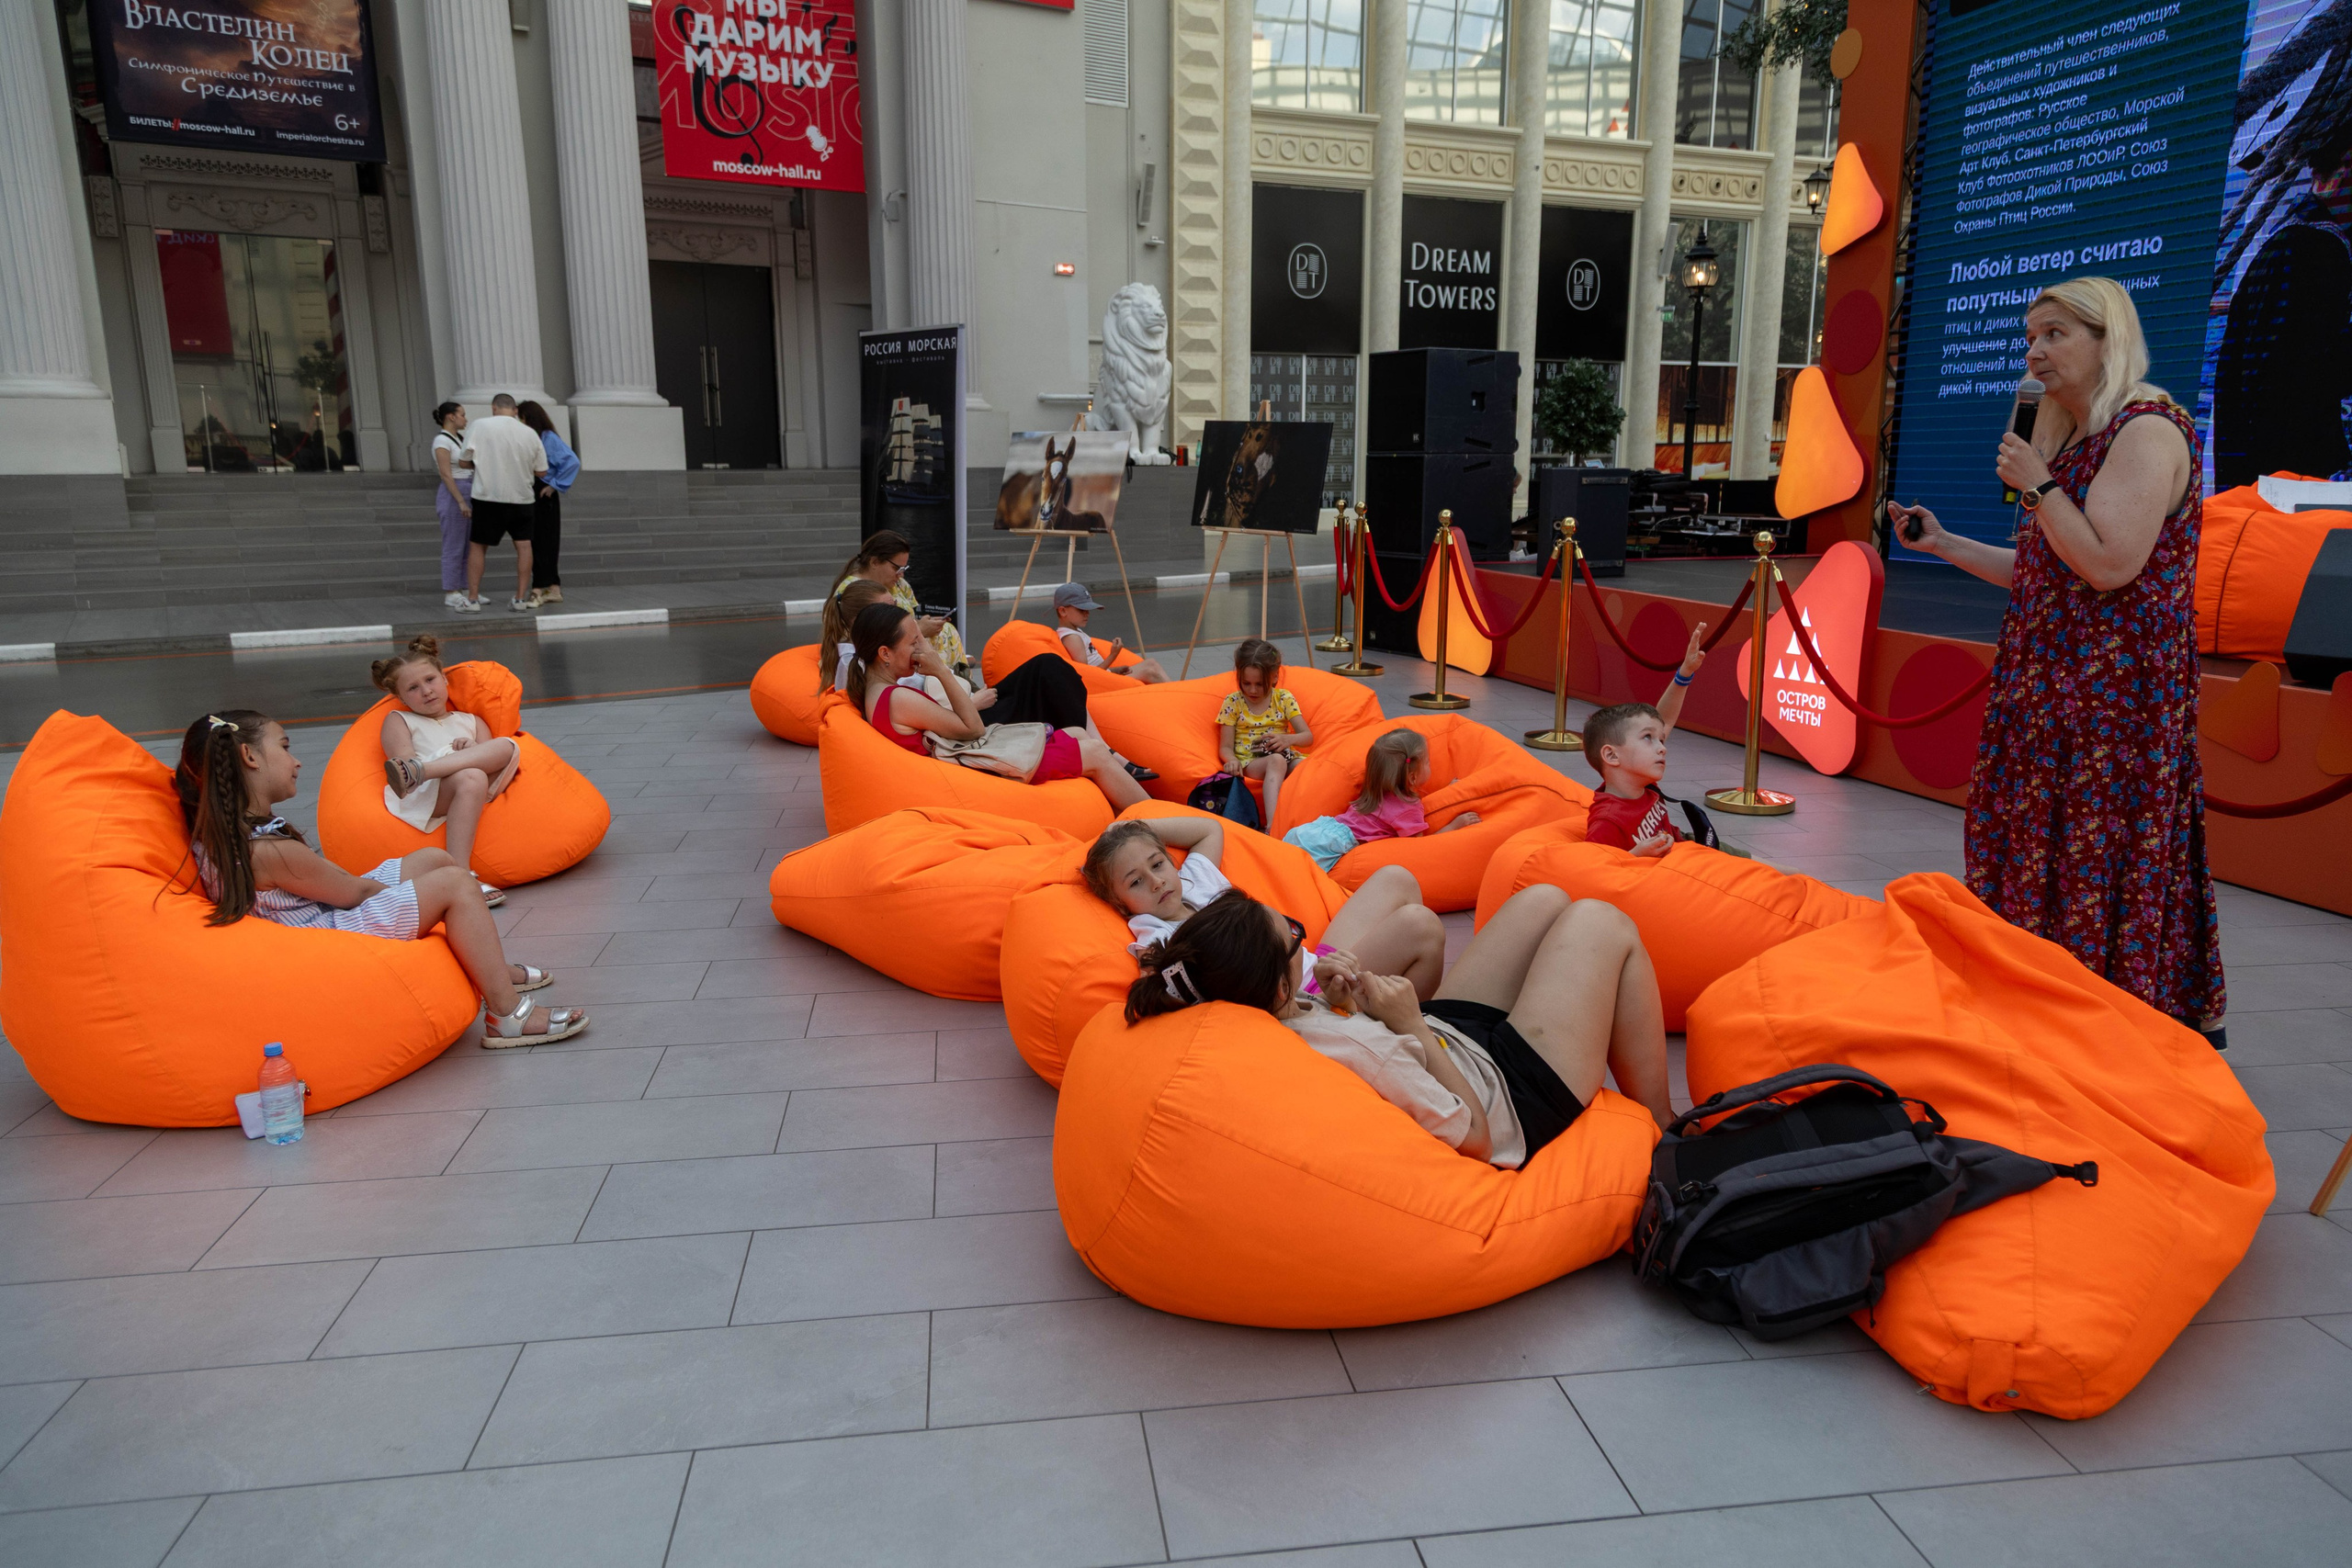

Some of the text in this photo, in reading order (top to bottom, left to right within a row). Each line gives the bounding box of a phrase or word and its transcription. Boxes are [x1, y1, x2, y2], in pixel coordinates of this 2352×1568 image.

[726, 0, 788, 19] МЫ
[691, 14, 823, 56] ДАРИМ
[1968, 3, 2181, 81] Действительный член следующих
[684, 45, 835, 89] МУЗЫКУ
[1966, 28, 2169, 97] объединений путешественников,
[1964, 64, 2118, 117] визуальных художников и
[334, 114, 361, 131] 6+
[1961, 85, 2185, 156] географическое общество, Морской
[1962, 95, 2088, 139] фотографов: Русское
[277, 130, 366, 147] imperialorchestra.ru
[1959, 118, 2148, 175] Арт Клуб, Санкт-Петербургский
[713, 161, 822, 181] moscow-hall.ru
[1958, 138, 2168, 195] Клуб Фотоохотников ЛООиР, Союз
[1956, 159, 2169, 213] Фотографов Дикой Природы, Союз
[1954, 203, 2076, 234] Охраны Птиц России.
[1411, 242, 1491, 275] DREAM
[1949, 236, 2164, 284] Любой ветер считаю
[1404, 279, 1497, 311] TOWERS
[1944, 321, 1971, 335] птиц
[1973, 318, 1981, 332] и
[1984, 316, 2019, 333] диких
[865, 336, 957, 356] РОССИЯ МОРСКАЯ
[1942, 336, 2007, 358] улучшение
[1940, 356, 2006, 376] отношений
[1938, 378, 1973, 399] дикой
[1777, 690, 1826, 710] ОСТРОВ
[1779, 706, 1822, 728] МЕЧТЫ
